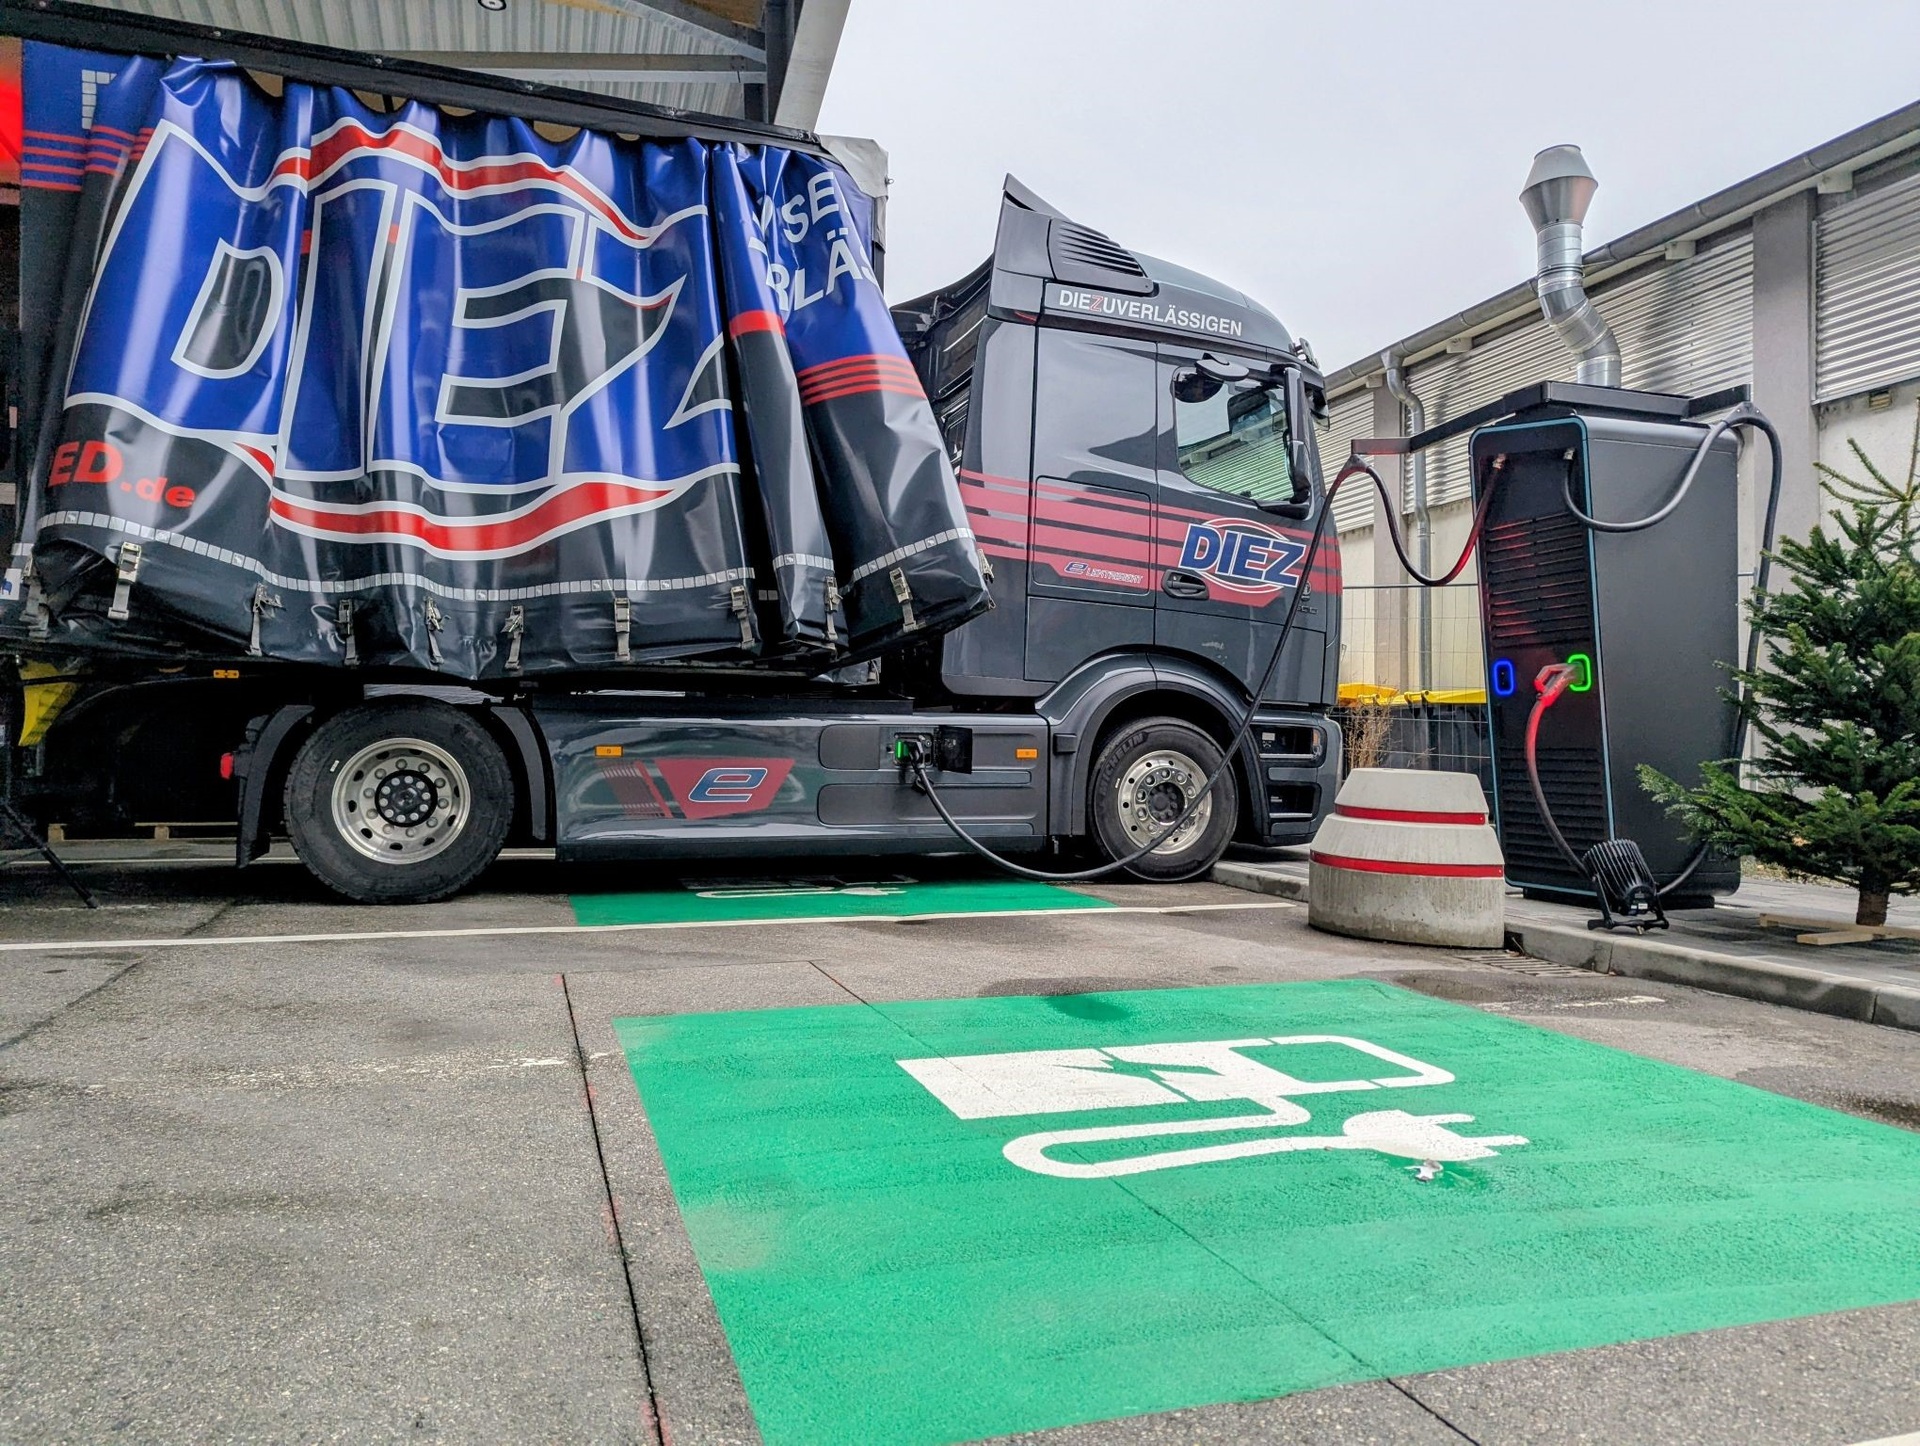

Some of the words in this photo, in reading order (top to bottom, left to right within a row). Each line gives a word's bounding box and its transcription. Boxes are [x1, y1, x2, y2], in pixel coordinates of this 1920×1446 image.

[64, 119, 741, 495] DIEZ
[1059, 289, 1242, 336] DIEZUVERLÄSSIGEN
[1178, 523, 1307, 588] DIEZ
